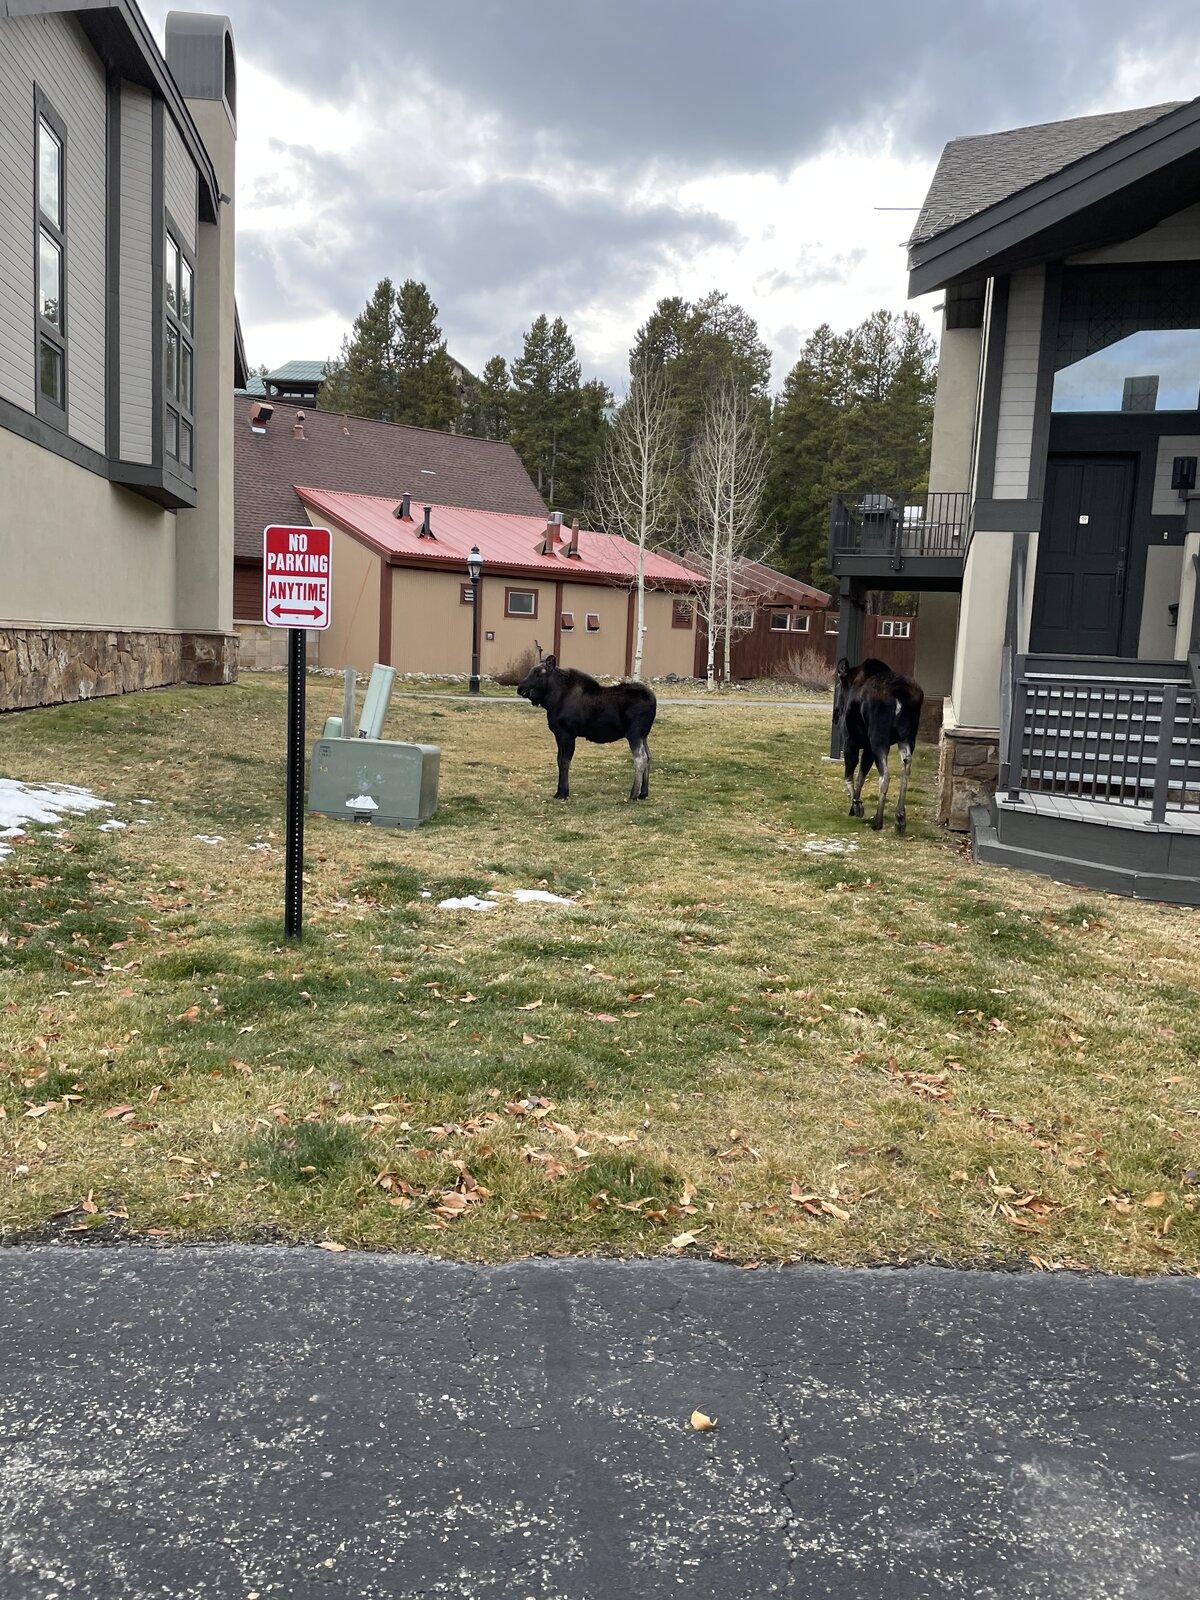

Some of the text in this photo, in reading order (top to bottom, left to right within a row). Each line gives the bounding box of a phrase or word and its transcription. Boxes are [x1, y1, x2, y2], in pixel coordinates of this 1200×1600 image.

[288, 533, 308, 553] NO
[267, 552, 328, 573] PARKING
[269, 581, 326, 602] ANYTIME
